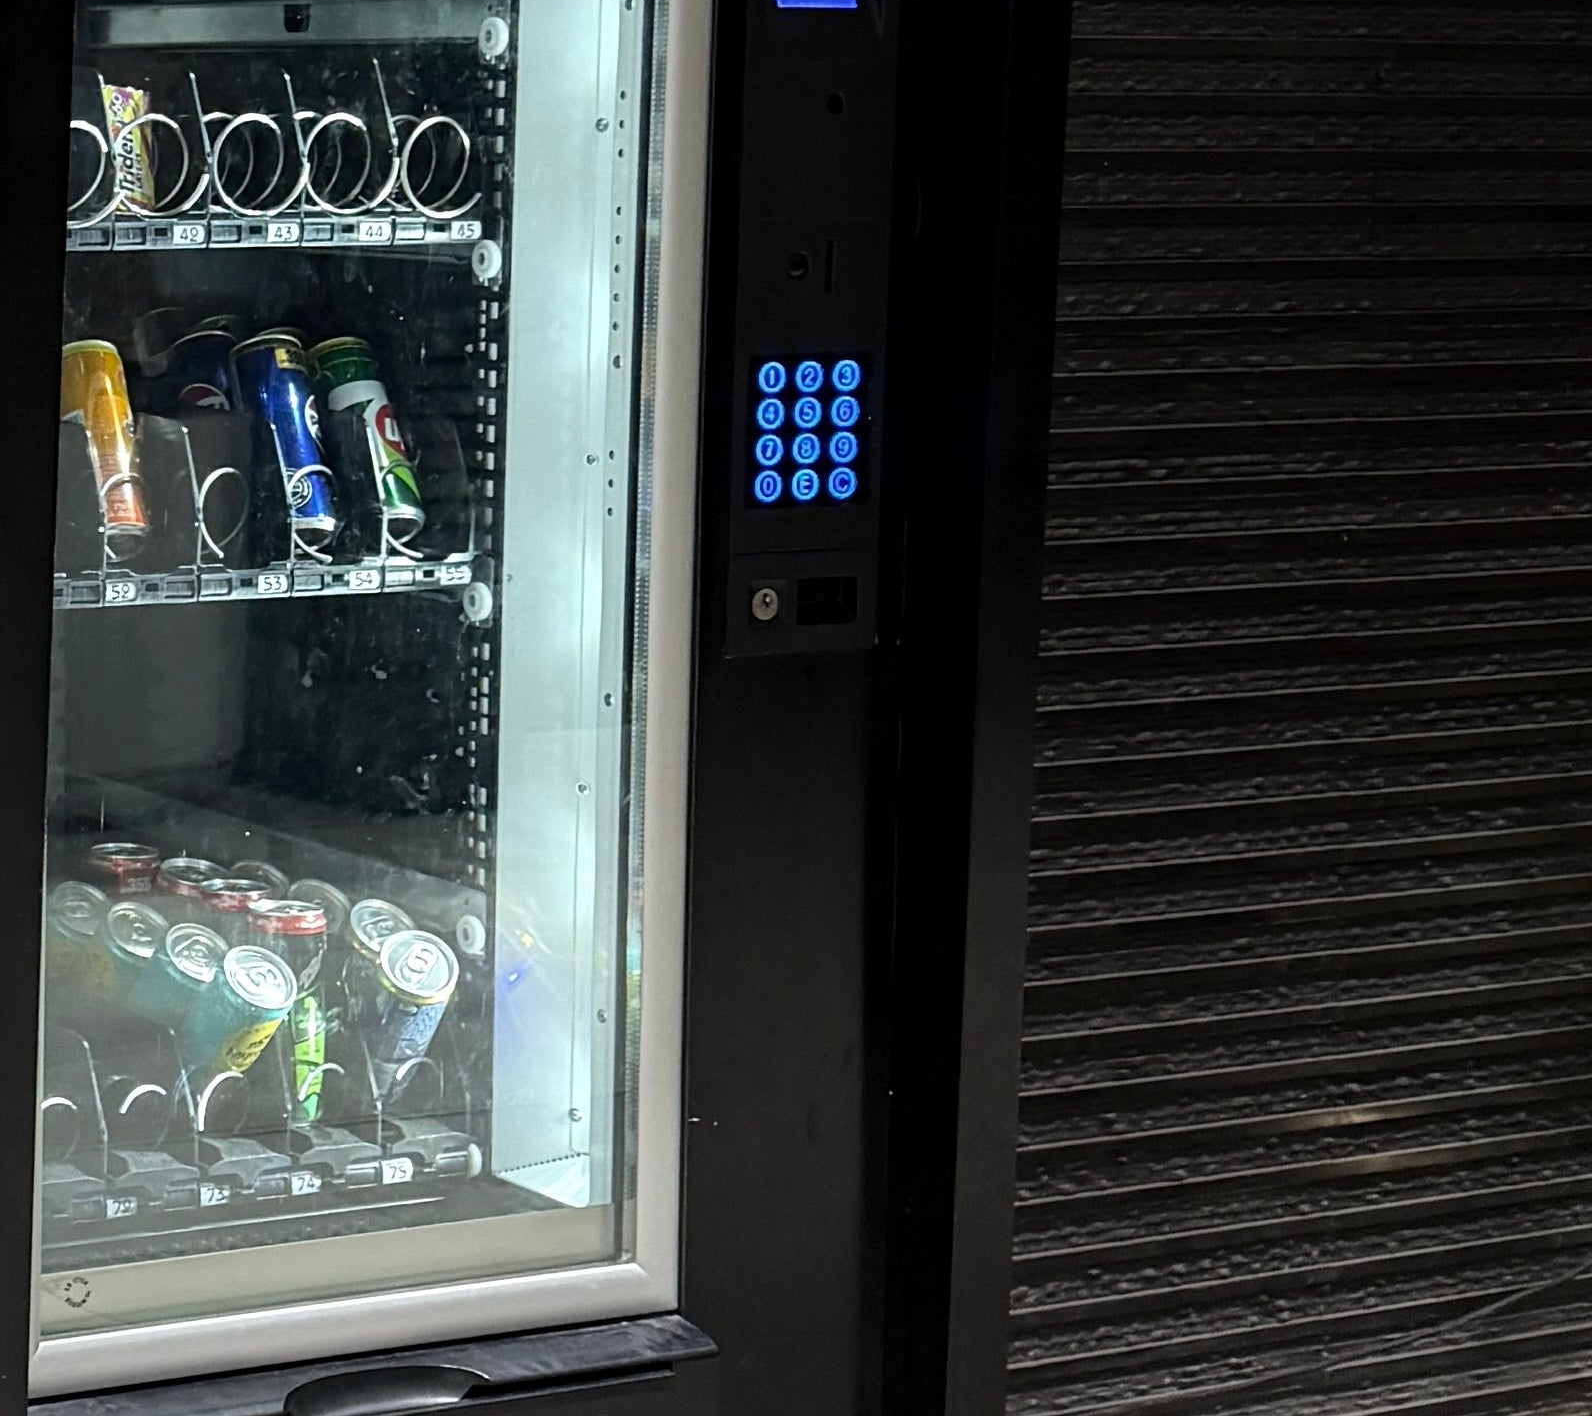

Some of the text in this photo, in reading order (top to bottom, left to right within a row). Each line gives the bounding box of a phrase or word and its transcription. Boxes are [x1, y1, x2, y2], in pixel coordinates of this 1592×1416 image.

[117, 123, 135, 193] Triden
[179, 223, 475, 242] 42 43 44 45
[111, 566, 466, 601] 52 53 54 55
[207, 1187, 226, 1203] 73
[297, 1176, 316, 1192] 74
[389, 1165, 407, 1179] 75
